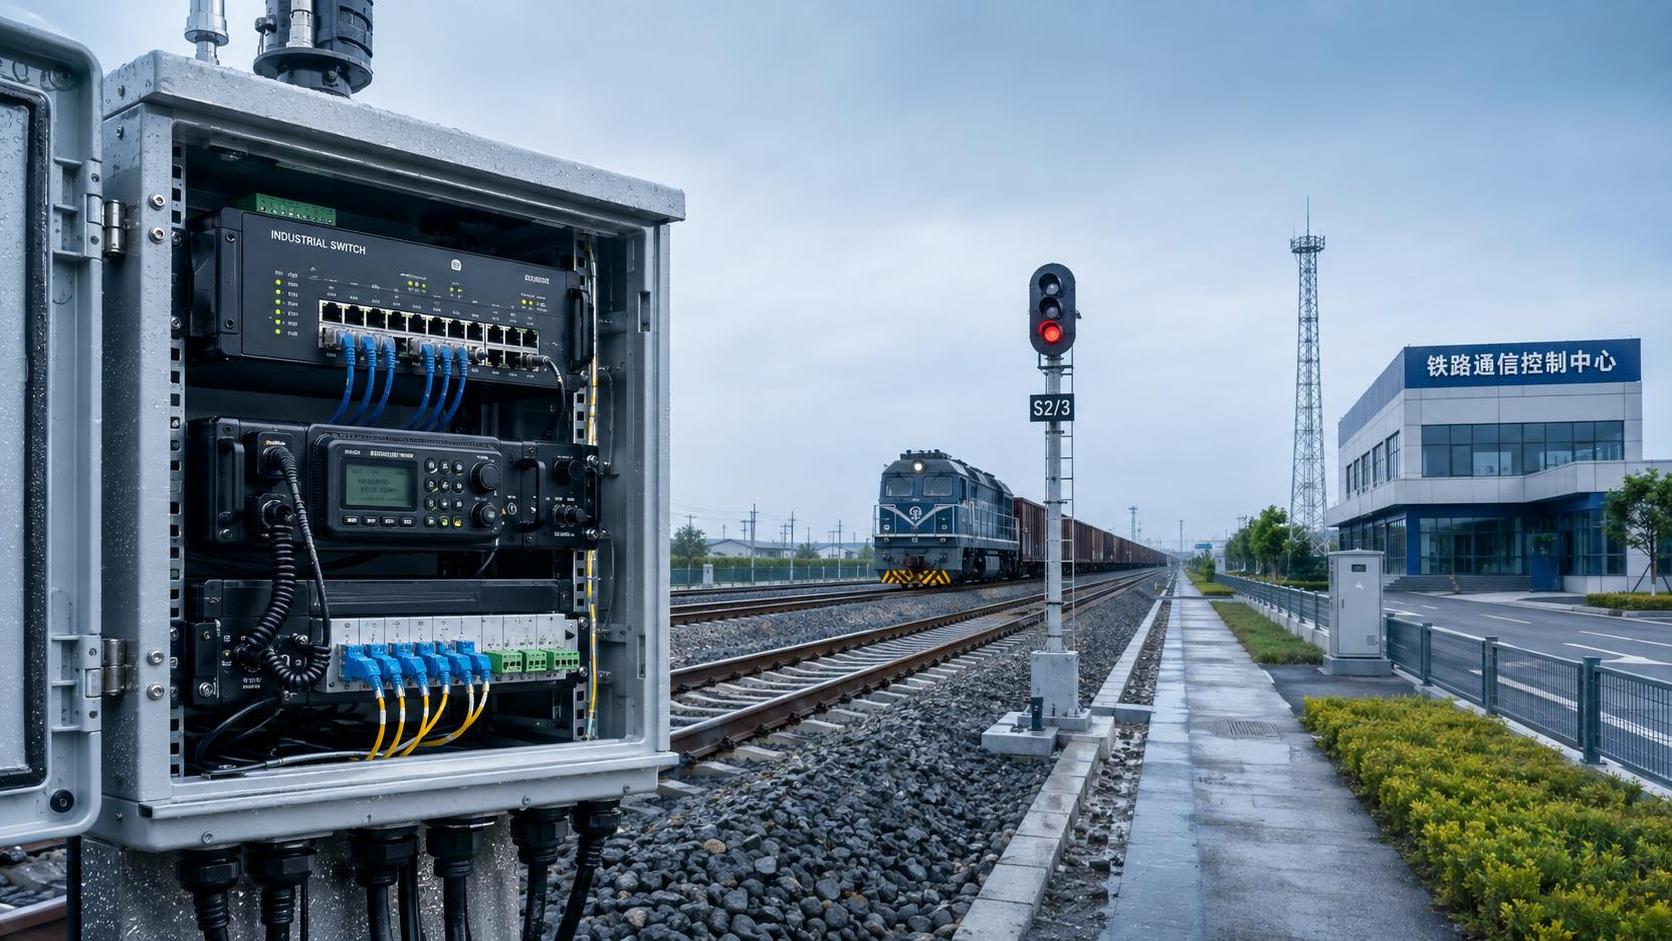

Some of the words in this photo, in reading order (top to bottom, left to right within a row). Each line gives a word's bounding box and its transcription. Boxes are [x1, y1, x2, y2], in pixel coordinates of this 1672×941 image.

[271, 229, 328, 249] INDUSTRIAL
[330, 240, 366, 255] SWITCH
[1427, 349, 1616, 377] 铁路通信控制中心
[1034, 400, 1070, 416] S2/3
